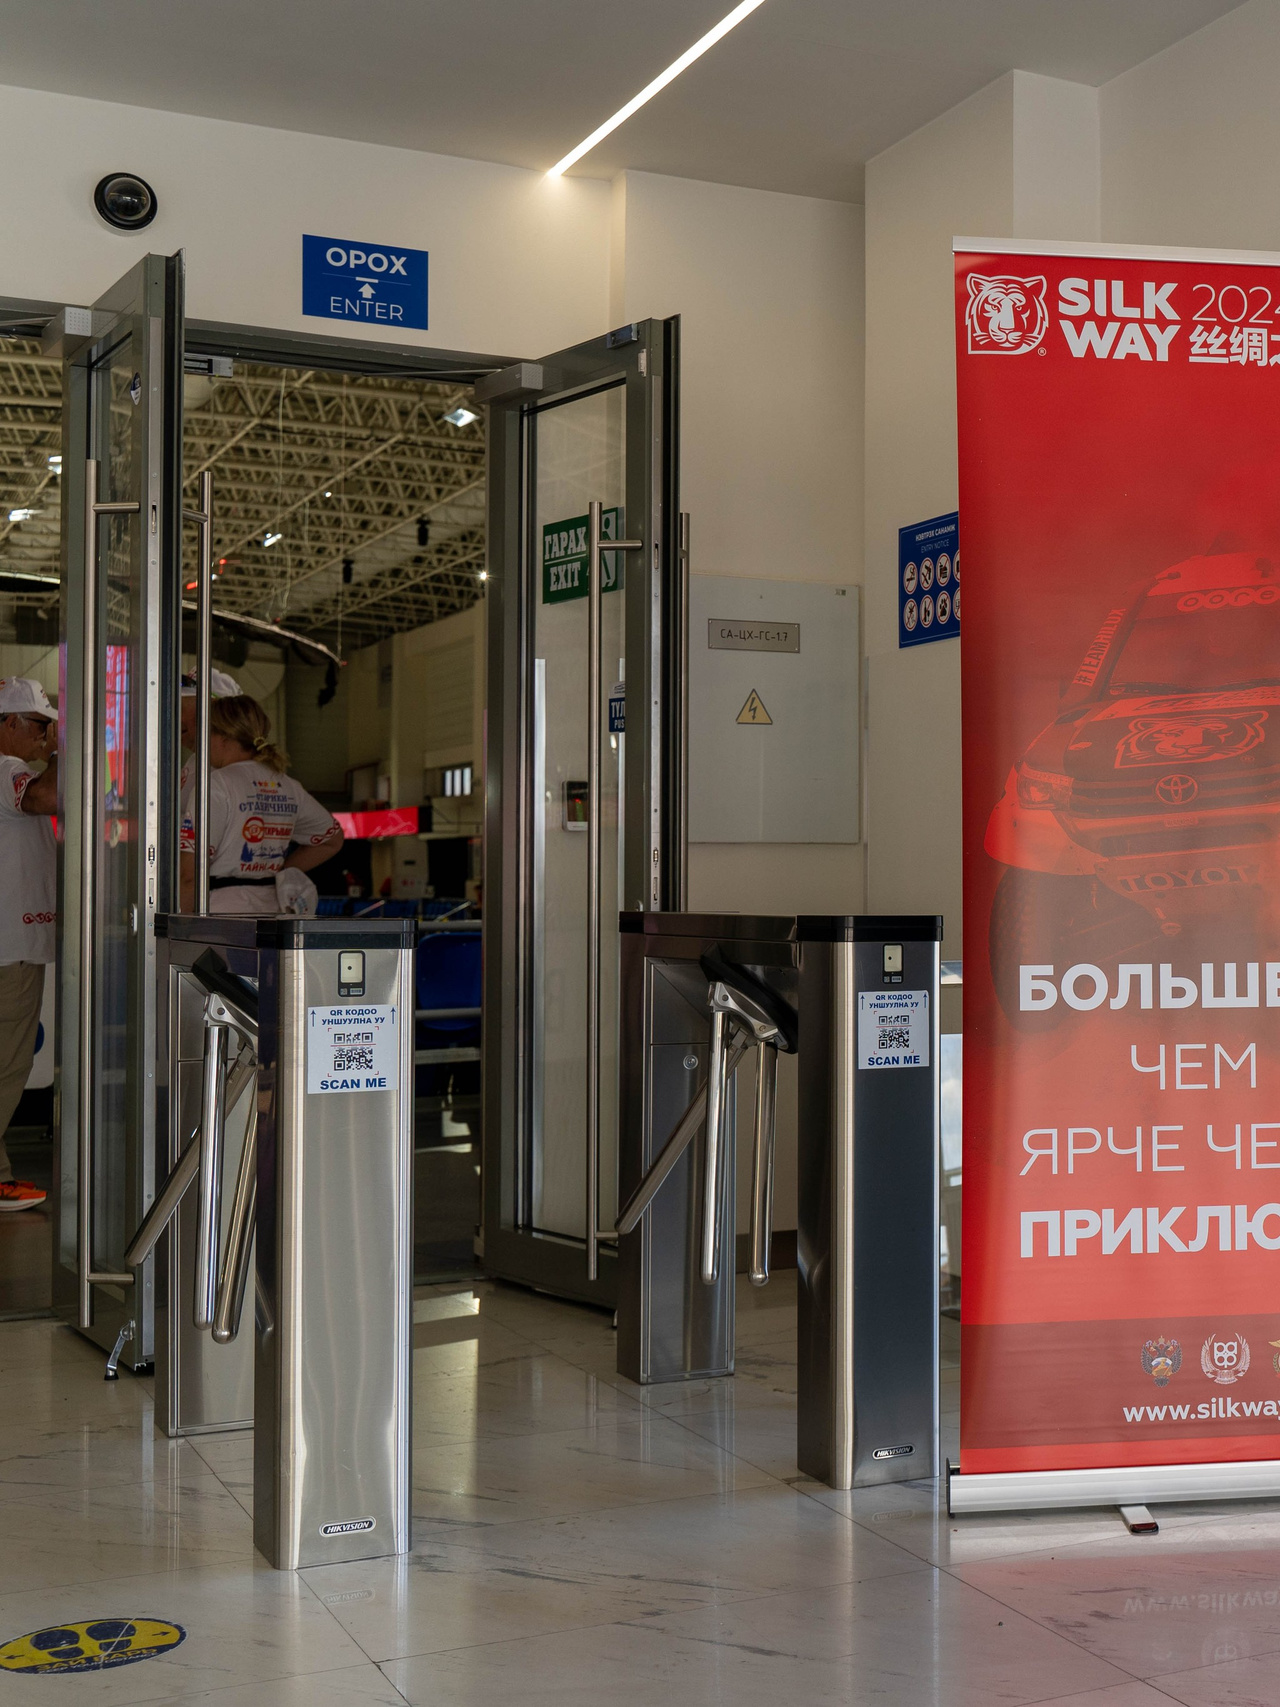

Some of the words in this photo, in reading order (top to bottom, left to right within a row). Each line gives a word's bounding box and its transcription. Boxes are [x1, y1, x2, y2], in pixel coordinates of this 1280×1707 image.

[326, 247, 408, 276] ОРОХ
[330, 296, 404, 321] ENTER
[1057, 276, 1178, 319] SILK
[1058, 319, 1181, 362] WAY
[544, 526, 586, 560] ГАРАХ
[921, 544, 934, 554] ENTRY
[934, 538, 950, 549] NOTICE
[550, 562, 580, 592] EXIT
[1073, 608, 1127, 687] #TEAMHILUX
[1117, 864, 1257, 893] TOYOT
[346, 1008, 377, 1016] КОДОО
[868, 1056, 900, 1066] SCAN
[904, 1055, 920, 1064] ME
[1131, 1042, 1257, 1091] ЧЕМ
[320, 1078, 360, 1090] SCAN
[366, 1078, 386, 1088] ME
[1019, 1124, 1185, 1176] ЯРЧЕ
[877, 1446, 910, 1457] HIKVISION
[326, 1521, 370, 1534] HIKVISION
